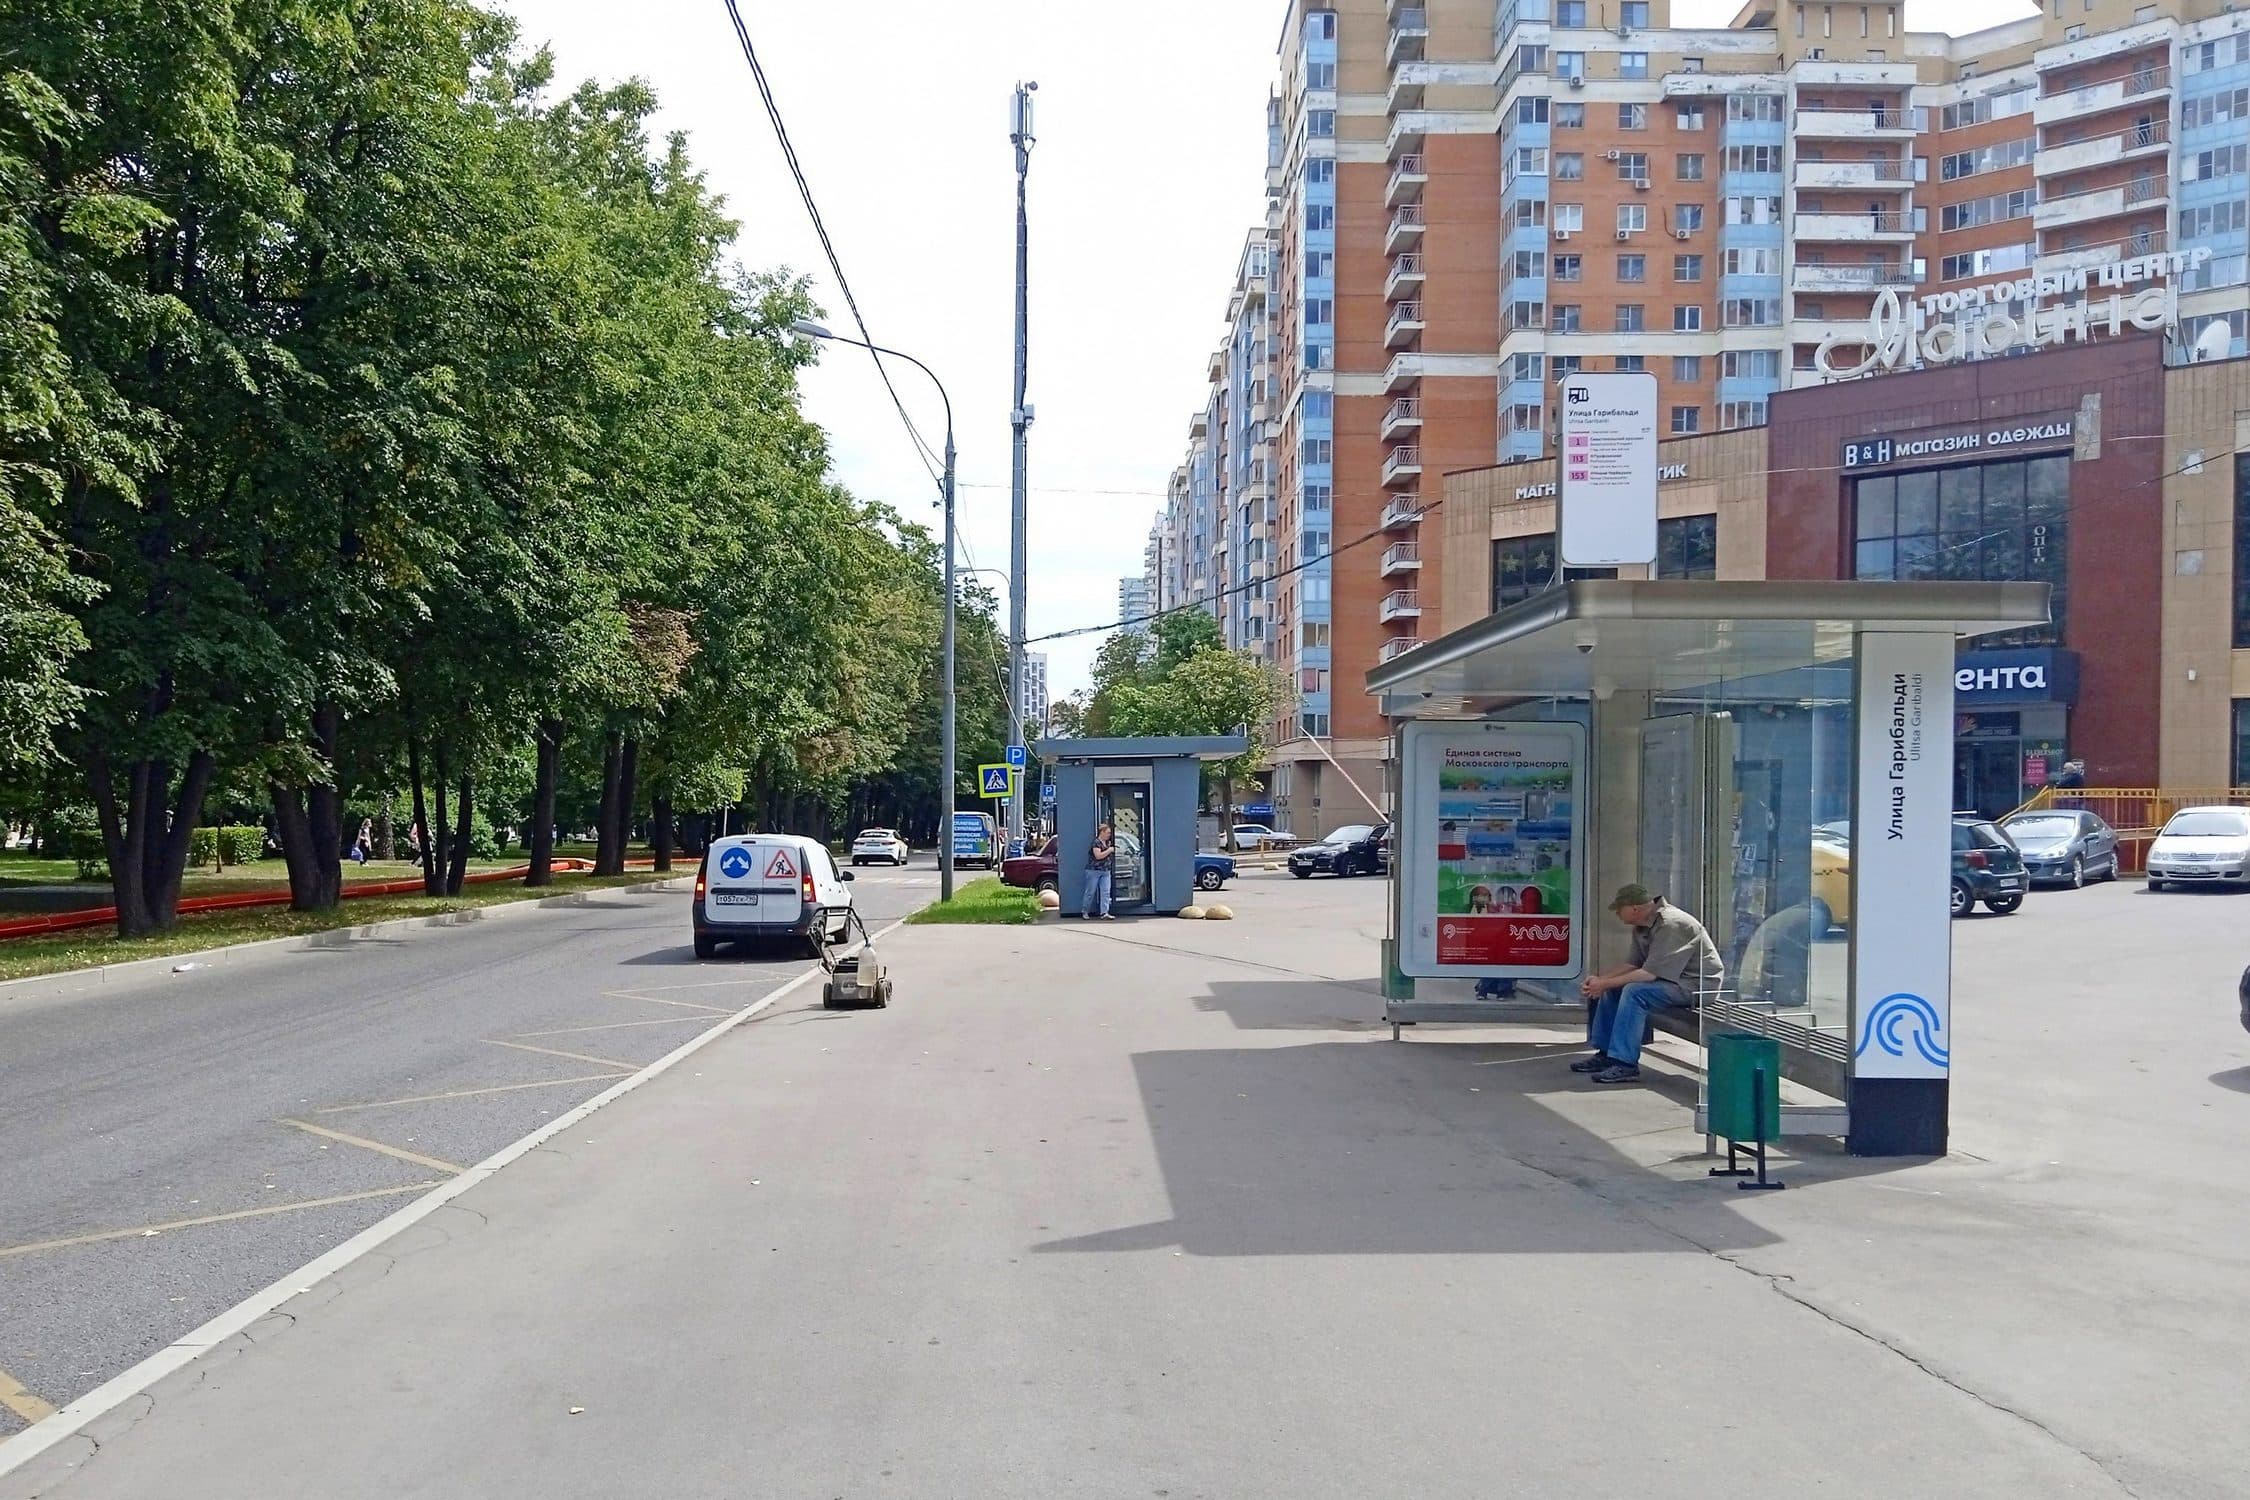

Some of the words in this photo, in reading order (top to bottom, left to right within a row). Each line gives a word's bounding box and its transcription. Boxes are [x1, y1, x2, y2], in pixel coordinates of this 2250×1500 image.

[1921, 265, 2087, 316] ТОРГОВЫЙ
[2098, 246, 2213, 289] ЦЕНТР
[1568, 409, 1592, 417] Улица
[1593, 408, 1639, 417] Гарибальди
[1895, 432, 1981, 457] магазин
[1986, 422, 2071, 446] одежды
[1572, 455, 1584, 463] 113
[1845, 443, 1858, 467] B
[1863, 446, 1873, 460] &
[1878, 439, 1890, 463] H
[1571, 472, 1585, 480] 153
[1515, 482, 1556, 500] МАГН
[1955, 665, 2047, 691] ента
[1911, 673, 1922, 727] Garibaldi
[1889, 673, 1908, 780] Гарибальди
[1011, 748, 1023, 764] P
[1445, 748, 1480, 758] Единая
[1482, 750, 1521, 758] система
[1445, 759, 1509, 768] Московского
[1512, 760, 1569, 770] транспорта
[1045, 786, 1053, 796] P
[1888, 786, 1905, 840] Улица
